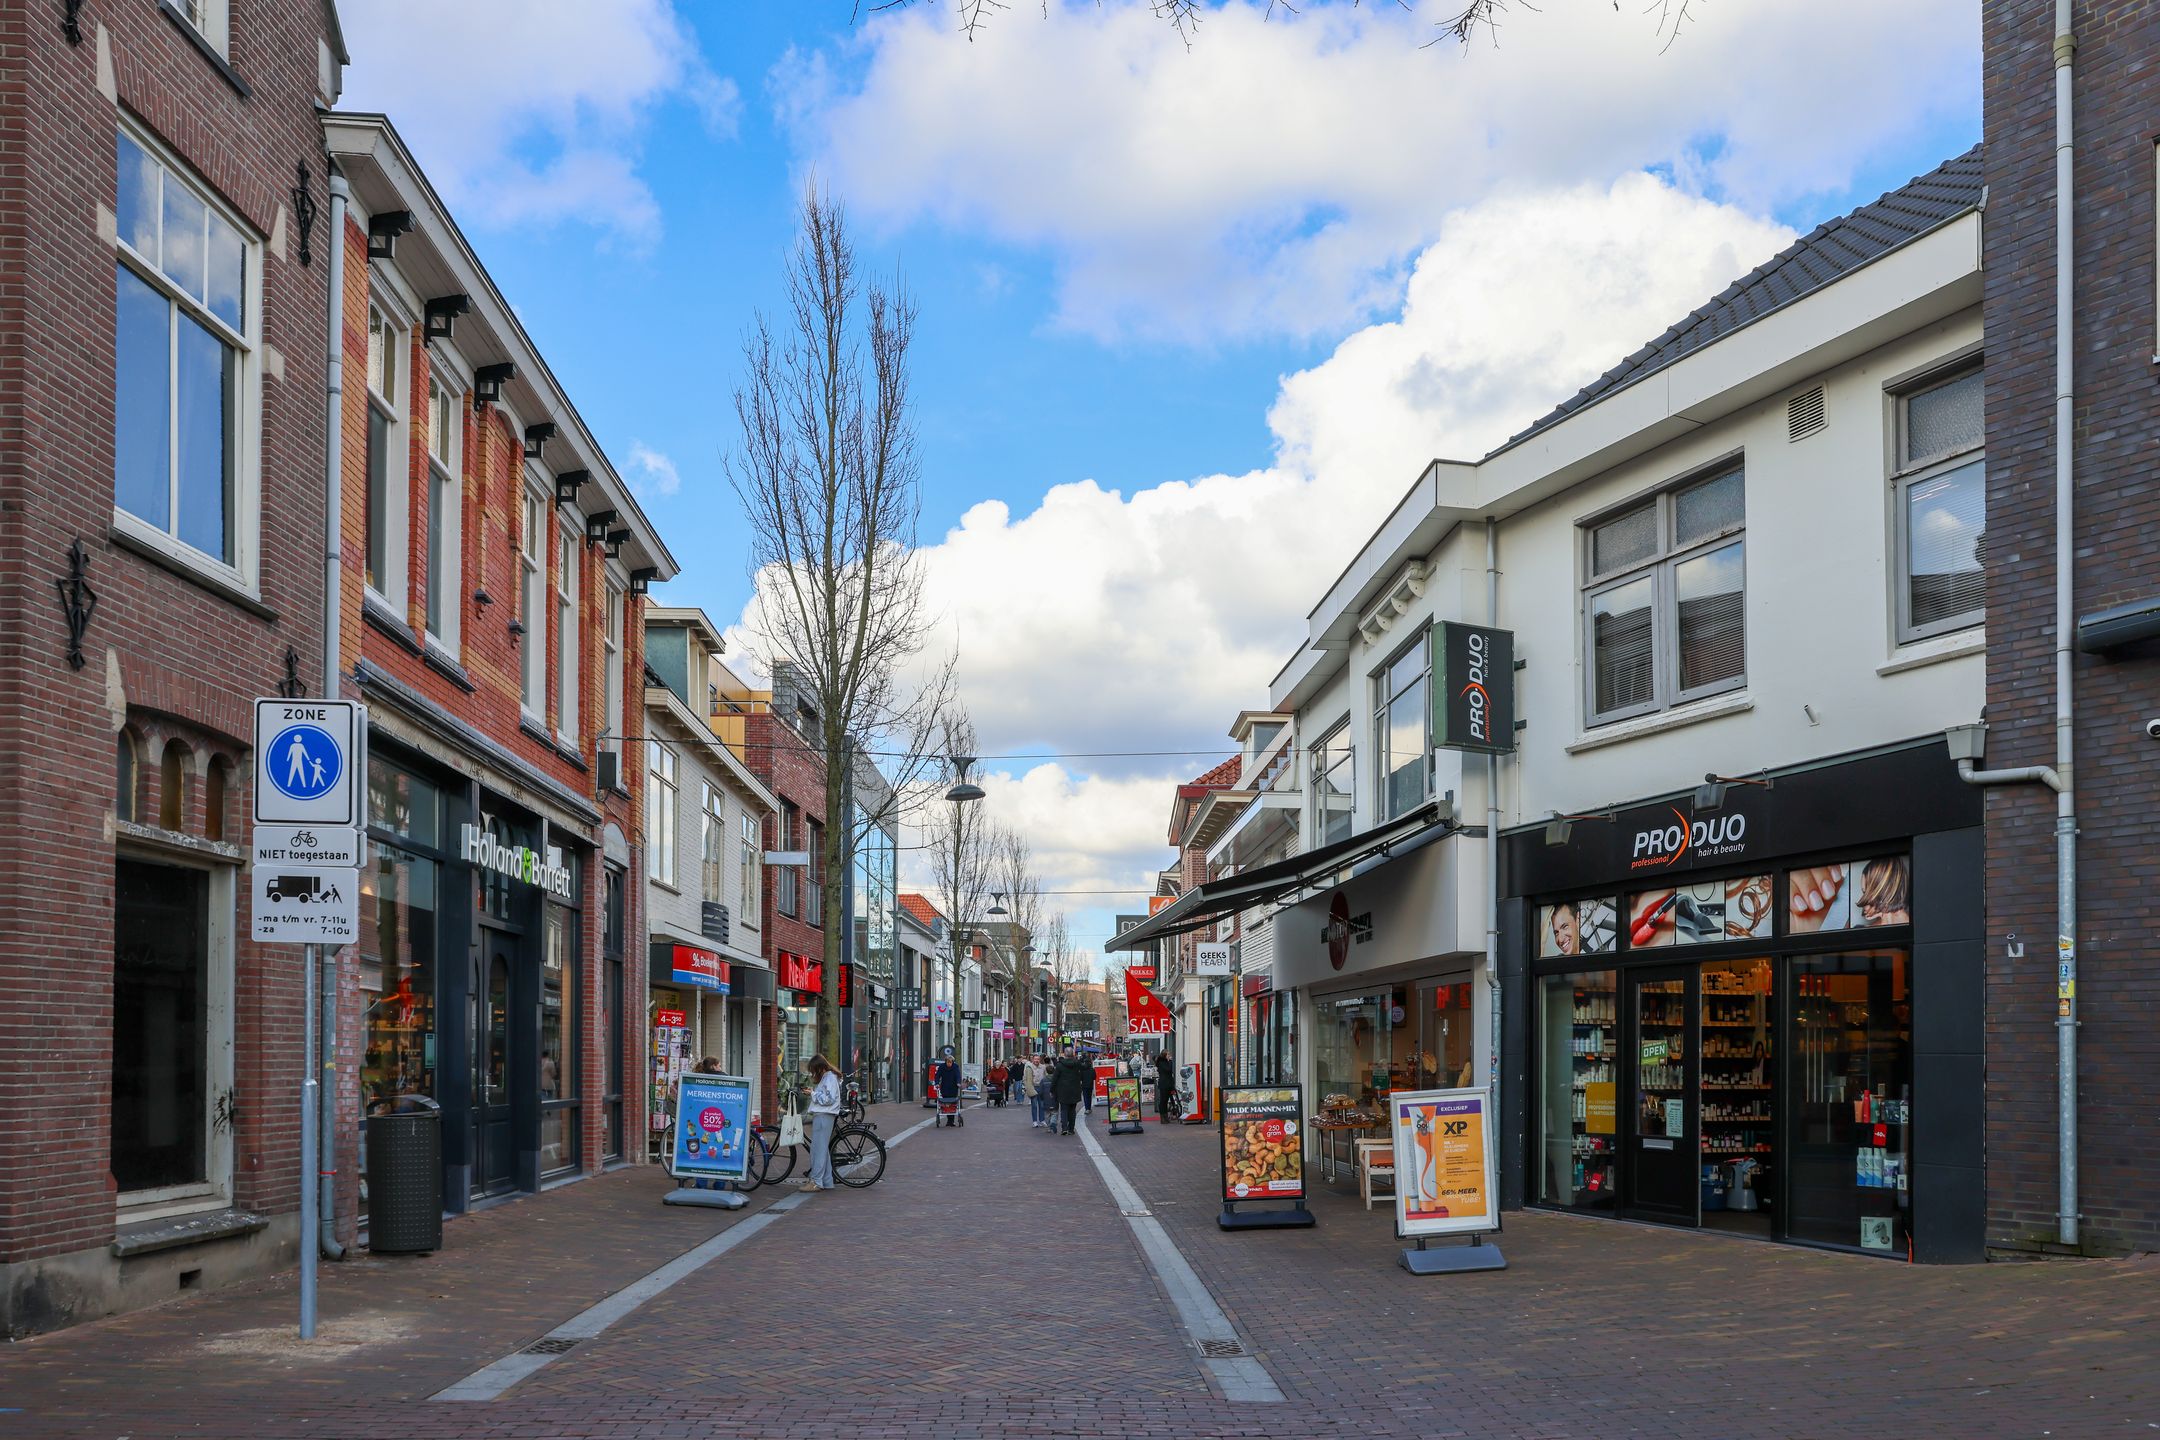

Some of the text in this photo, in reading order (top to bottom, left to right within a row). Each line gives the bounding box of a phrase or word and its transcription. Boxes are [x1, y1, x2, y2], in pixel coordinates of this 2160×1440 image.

[284, 708, 326, 720] ZONE
[260, 850, 349, 862] NIET toegestaan
[1698, 842, 1746, 858] hair & beauty
[461, 823, 522, 880] Holland
[532, 851, 570, 898] Barrett
[1630, 854, 1670, 870] professional
[282, 914, 300, 923] t/m
[320, 916, 346, 924] 7-11u
[321, 926, 350, 934] 7-10u
[1130, 1018, 1170, 1034] SALE
[1643, 1045, 1666, 1058] OPEN
[686, 1090, 744, 1101] MERKENSTORM
[1250, 1105, 1296, 1113] MANNEN-MIX
[704, 1116, 722, 1124] 50%
[1444, 1120, 1468, 1136] XP
